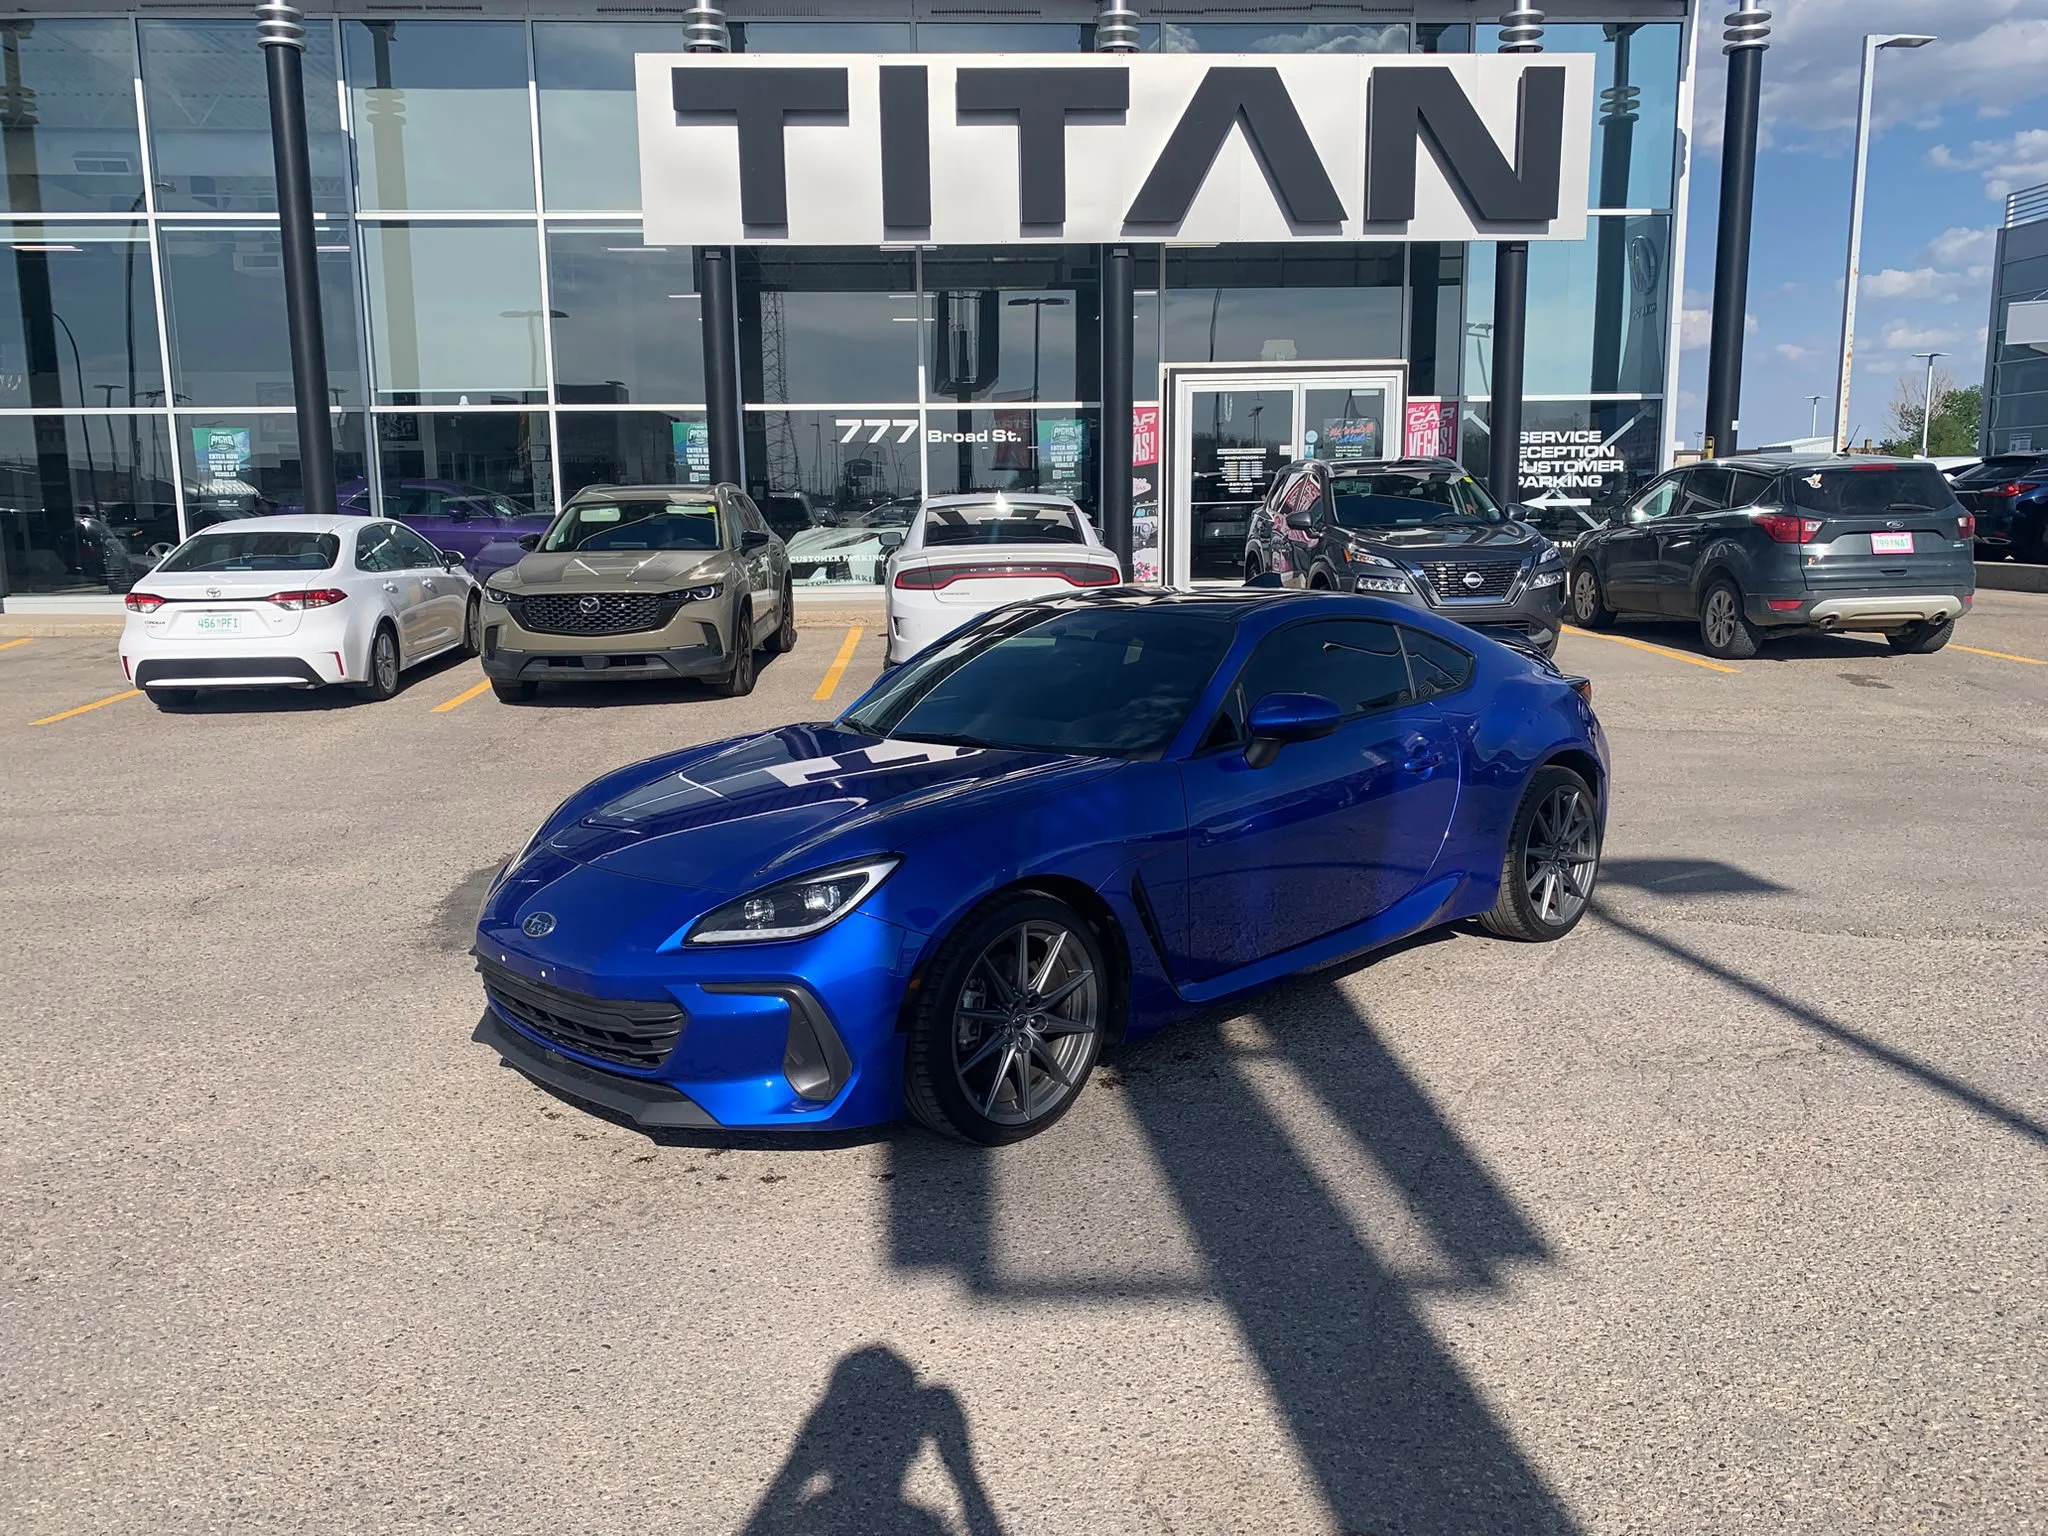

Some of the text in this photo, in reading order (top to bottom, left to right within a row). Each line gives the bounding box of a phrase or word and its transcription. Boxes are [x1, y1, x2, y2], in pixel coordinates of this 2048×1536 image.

[672, 65, 1565, 228] TITAN
[1408, 405, 1428, 414] BUY
[1409, 408, 1455, 426] CAR
[835, 419, 1022, 444] 777 Broad St.
[1411, 420, 1446, 432] GO TO
[1408, 426, 1453, 458] VEGAS!
[1520, 431, 1602, 443] SERVICE
[1519, 445, 1616, 458] ECEPTION
[789, 555, 841, 563] CUSTOMER
[198, 617, 239, 629] 456 PFI
